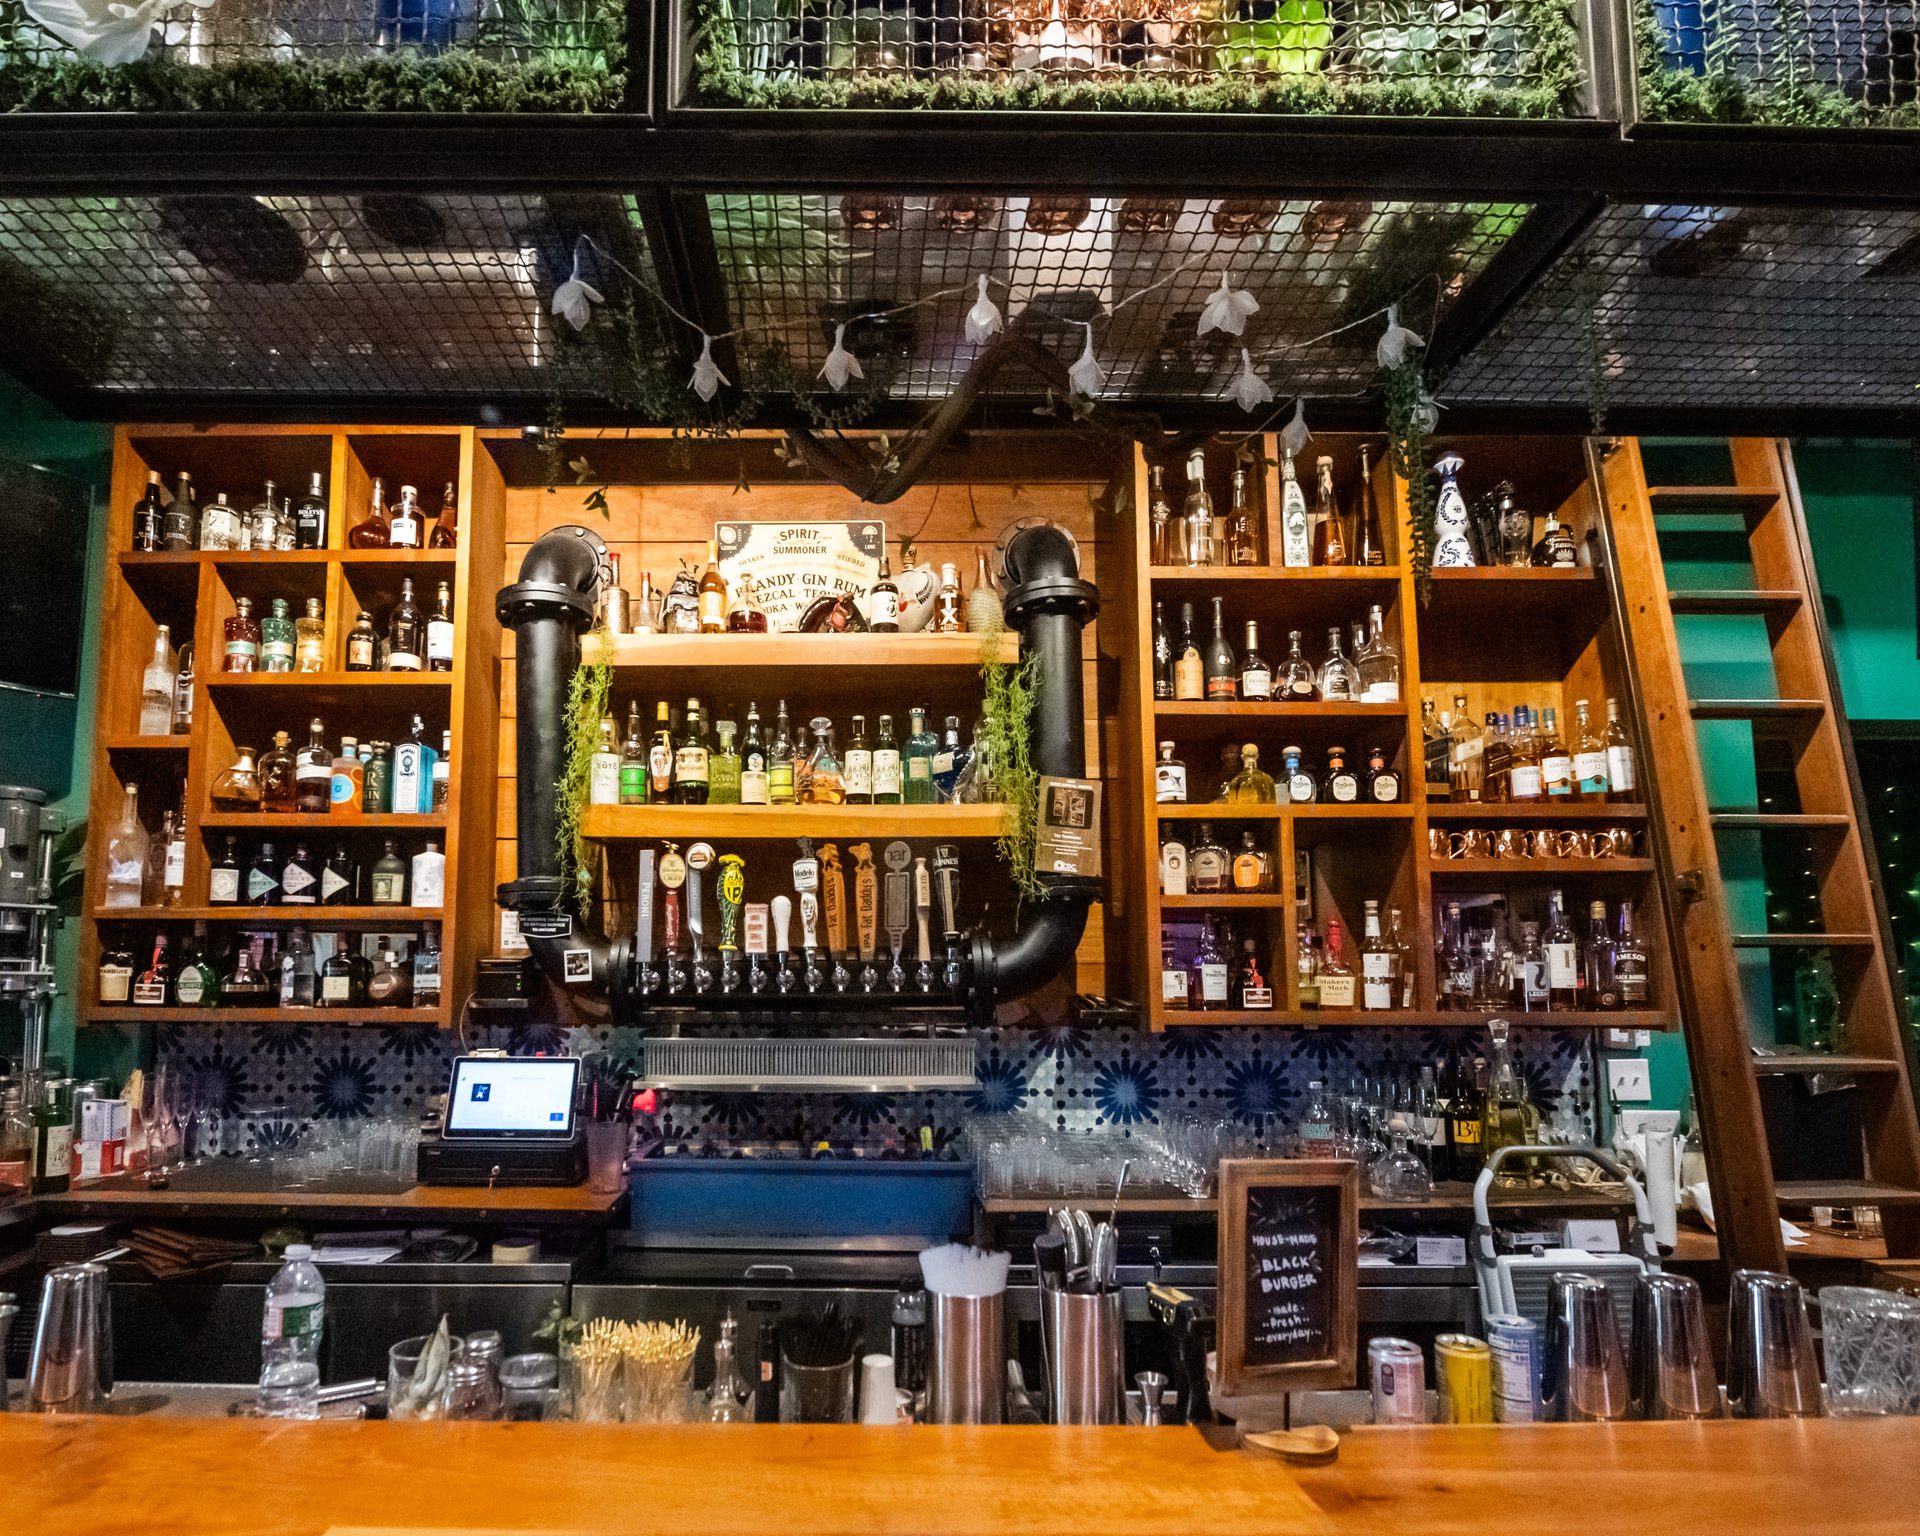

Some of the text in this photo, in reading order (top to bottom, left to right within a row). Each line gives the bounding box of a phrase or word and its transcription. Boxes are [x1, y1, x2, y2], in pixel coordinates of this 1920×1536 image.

[779, 528, 820, 541] SPIRIT
[773, 545, 827, 554] SUMMONER
[837, 554, 865, 568] STIRRED
[802, 573, 827, 586] GIN
[833, 578, 867, 599] RUM
[756, 588, 796, 604] EZCAL
[888, 849, 907, 862] rar
[933, 857, 958, 867] GUINNESS
[794, 867, 815, 878] Modelo
[919, 874, 928, 903] ALLAGASH
[641, 881, 652, 918] PERONI
[826, 877, 838, 929] Fat Daddy's
[861, 878, 873, 948] IPA Fat Daddy's
[1616, 953, 1647, 962] AMESON
[1252, 1234, 1318, 1246] HOUSE-MADE
[1262, 1256, 1310, 1272] BLACK
[1261, 1274, 1317, 1293] BURGER
[1273, 1302, 1299, 1315] made
[1266, 1329, 1311, 1344] everyday
